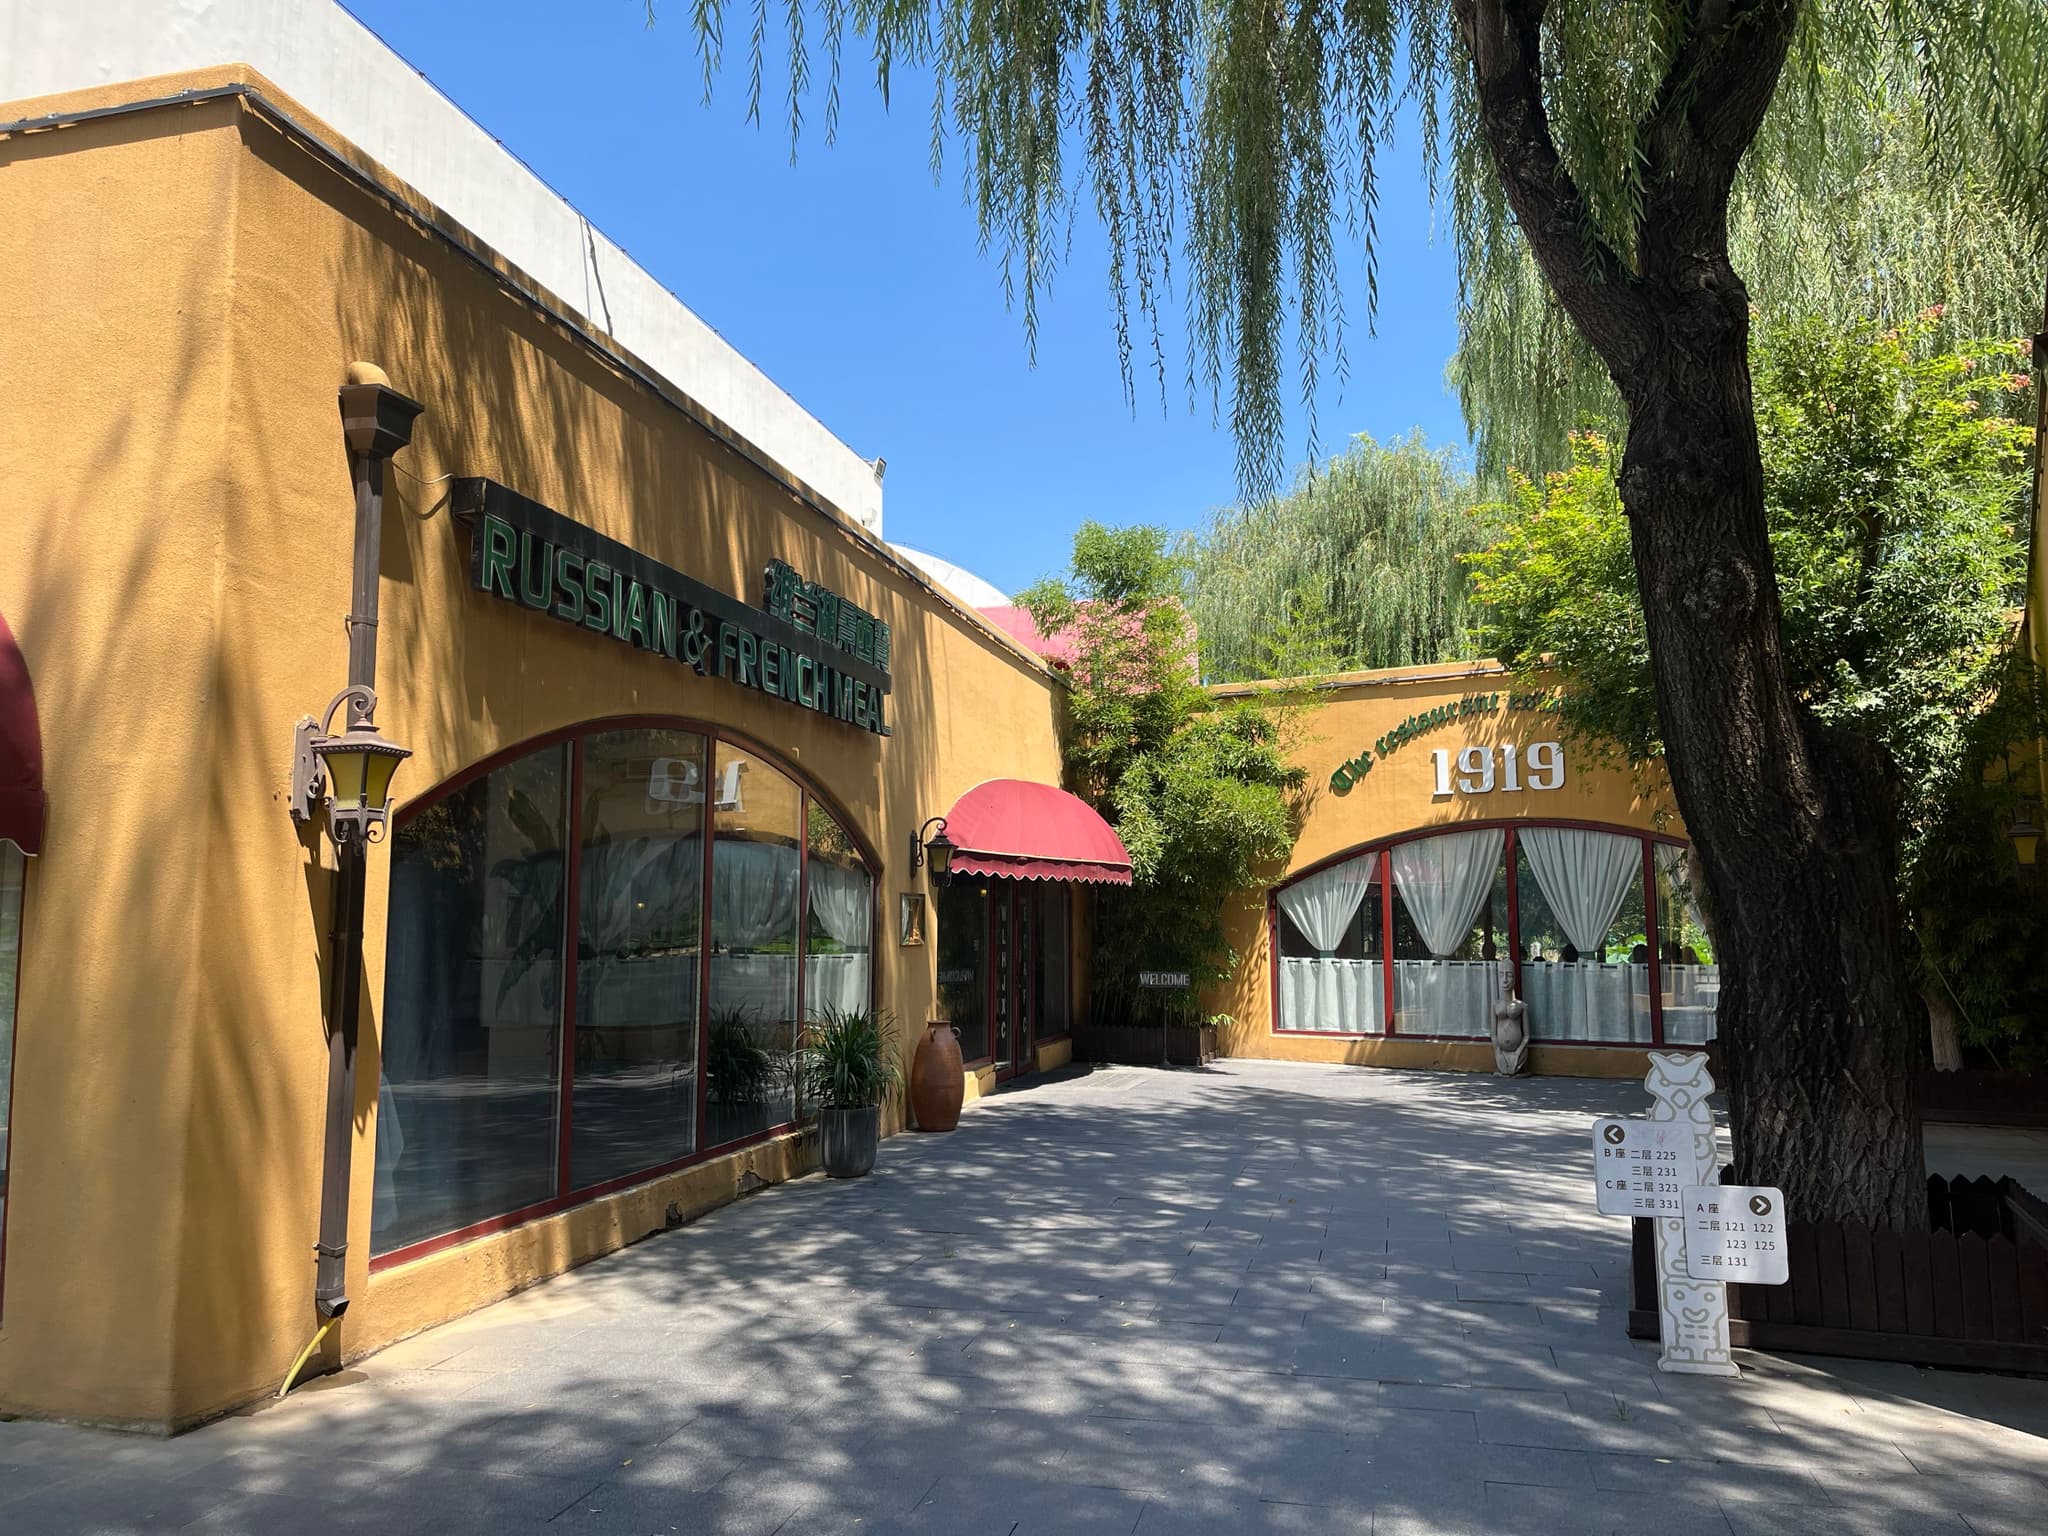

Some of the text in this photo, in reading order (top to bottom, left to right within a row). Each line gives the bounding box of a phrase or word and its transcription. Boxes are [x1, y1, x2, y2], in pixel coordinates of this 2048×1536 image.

[481, 514, 892, 736] RUSSIAN & FRENCH MEAL
[1376, 691, 1500, 752] restaurant
[1432, 741, 1565, 796] 1919
[1140, 972, 1189, 985] WELCOME
[1604, 1148, 1676, 1160] B 座 二层 225
[1632, 1166, 1677, 1176] 三层 231
[1605, 1180, 1678, 1192] C 座 二层 323
[1634, 1198, 1679, 1209] 三层 331
[1696, 1203, 1720, 1213] A 座
[1698, 1221, 1774, 1233] 二层 121 122
[1726, 1240, 1775, 1251] 123 125
[1701, 1255, 1748, 1266] 三层 131
